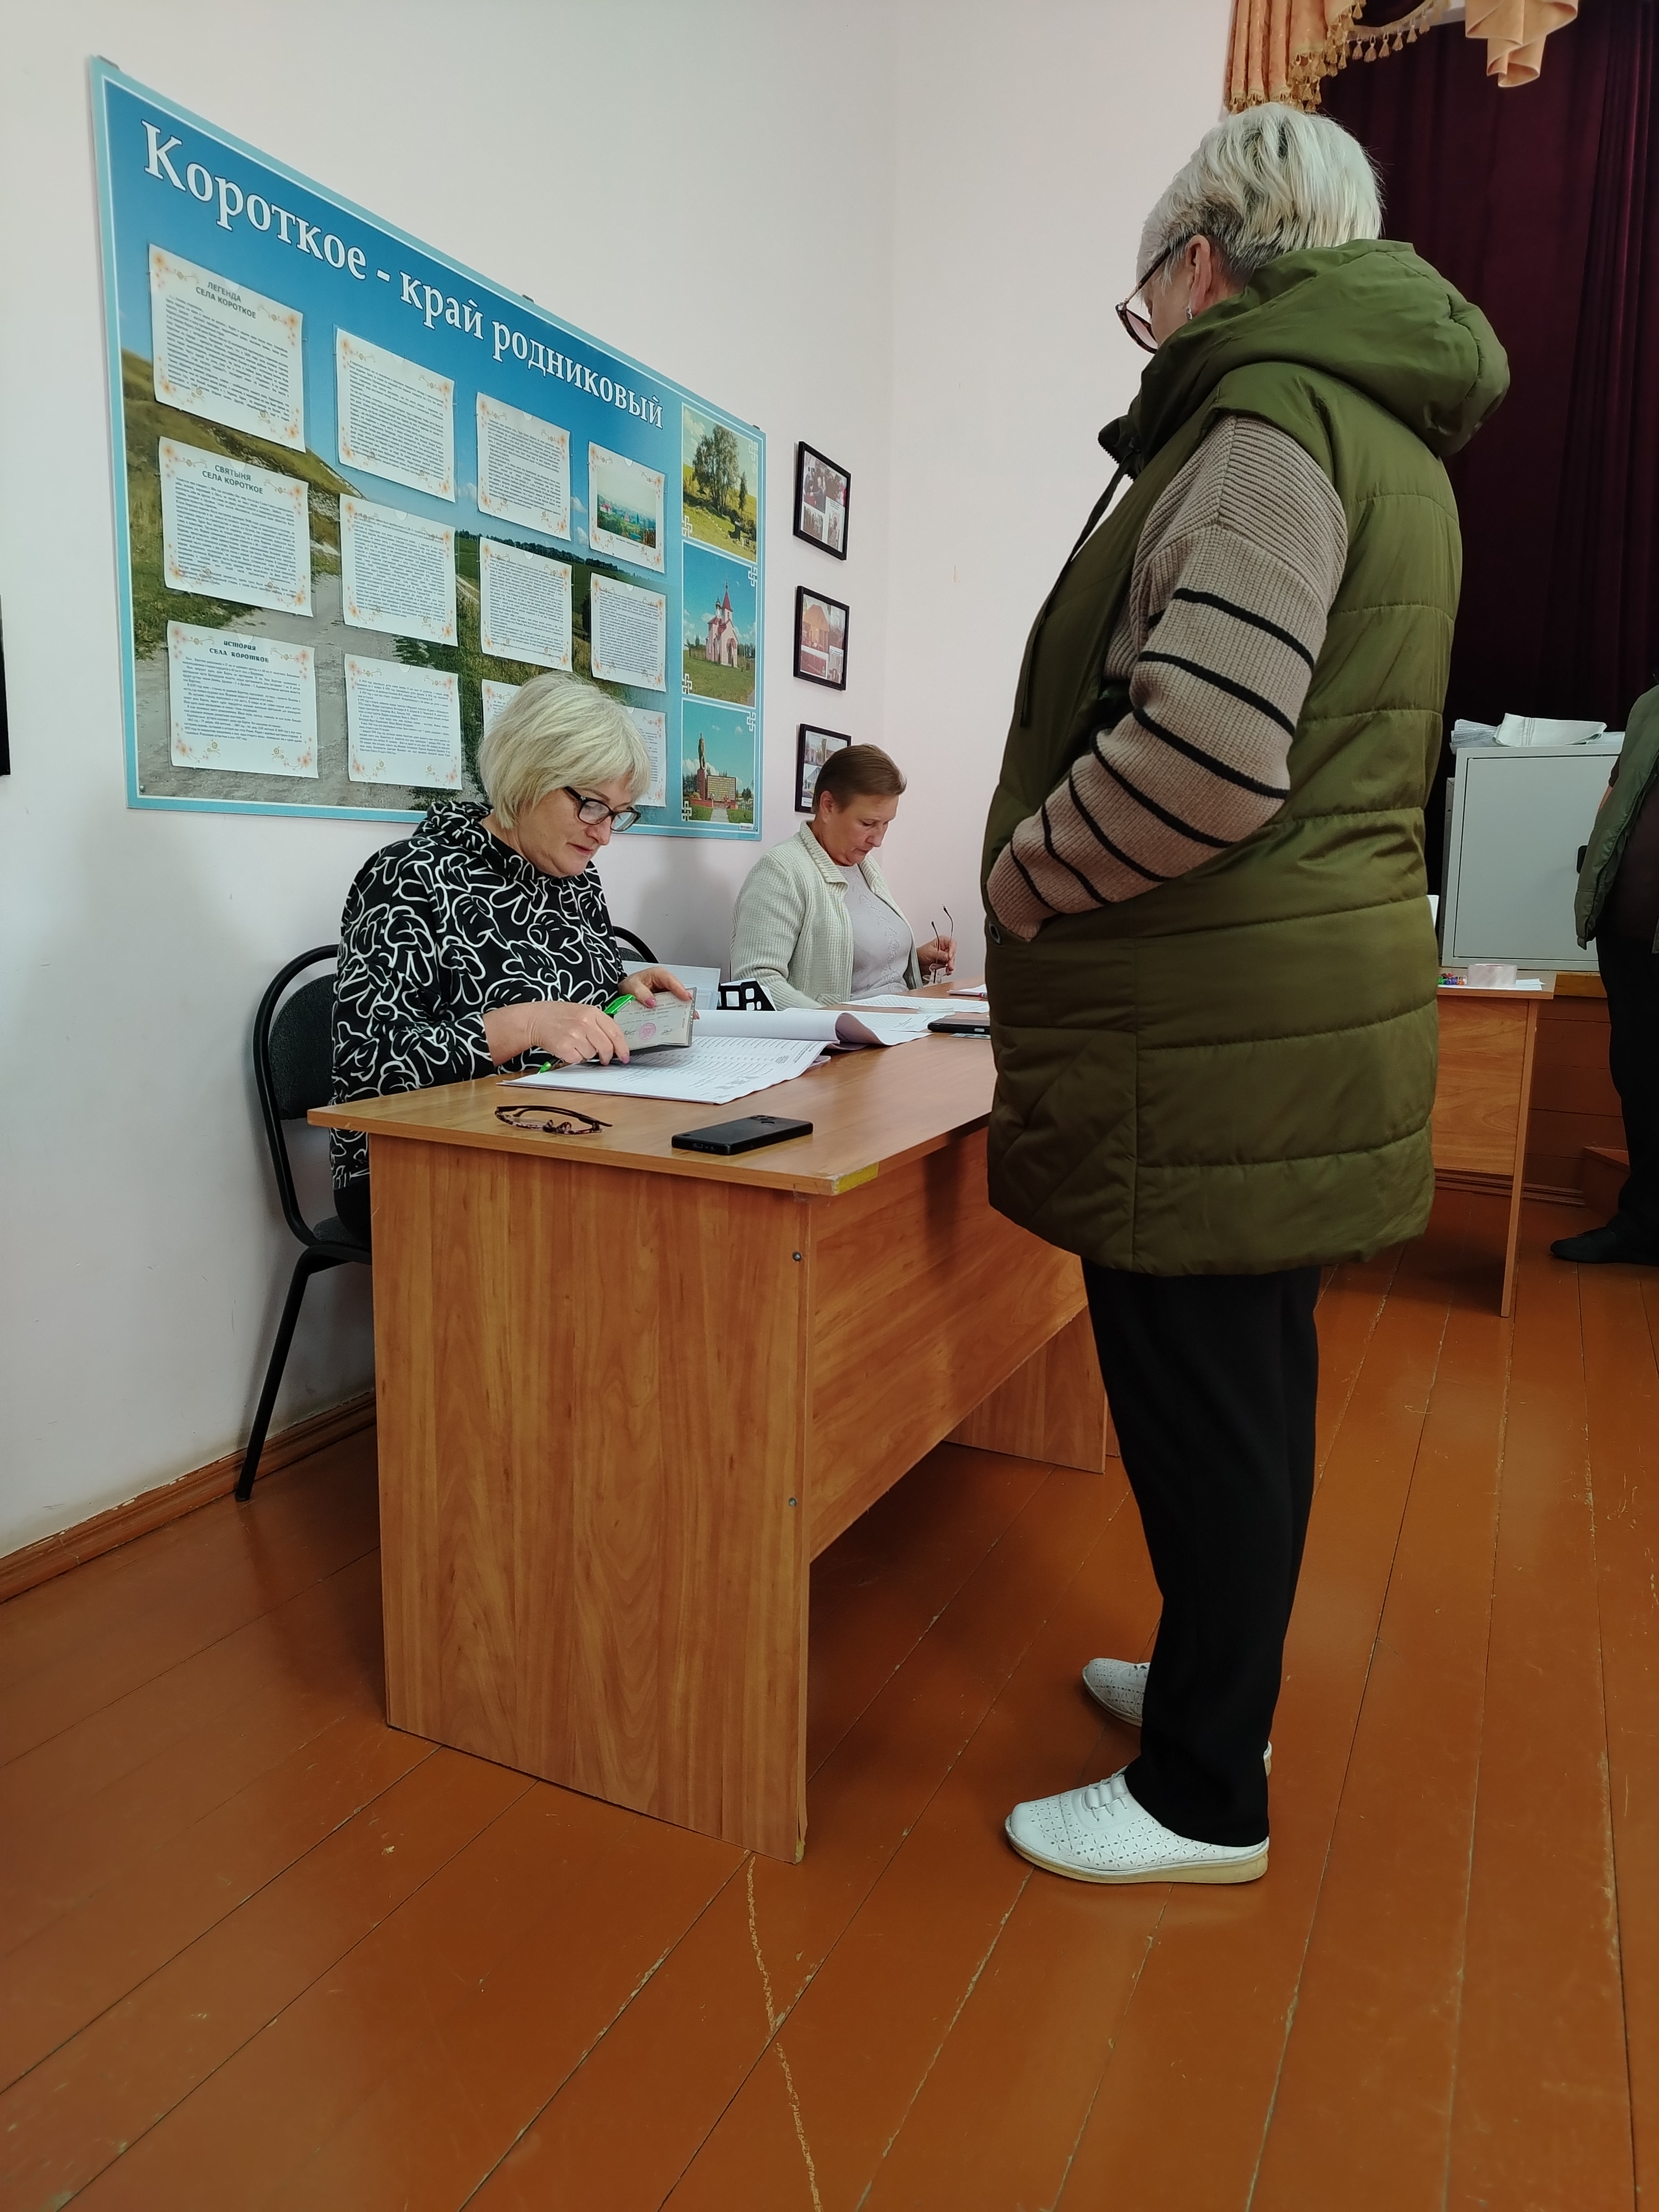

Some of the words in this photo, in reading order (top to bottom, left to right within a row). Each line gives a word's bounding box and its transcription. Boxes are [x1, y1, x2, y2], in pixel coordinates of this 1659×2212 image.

[142, 119, 367, 281] Короткое
[376, 269, 390, 282] -
[400, 270, 484, 340] край
[492, 320, 664, 430] родниковый
[207, 281, 241, 302] ЛЕГЕНДА
[196, 287, 216, 301] СЕЛА
[217, 297, 256, 319] КОРОТКОЕ
[202, 471, 222, 482] СЕЛА
[225, 477, 263, 494] КОРОТКОЕ
[215, 465, 251, 481] СВЯТЫНЯ
[209, 648, 227, 656] СЕЛА
